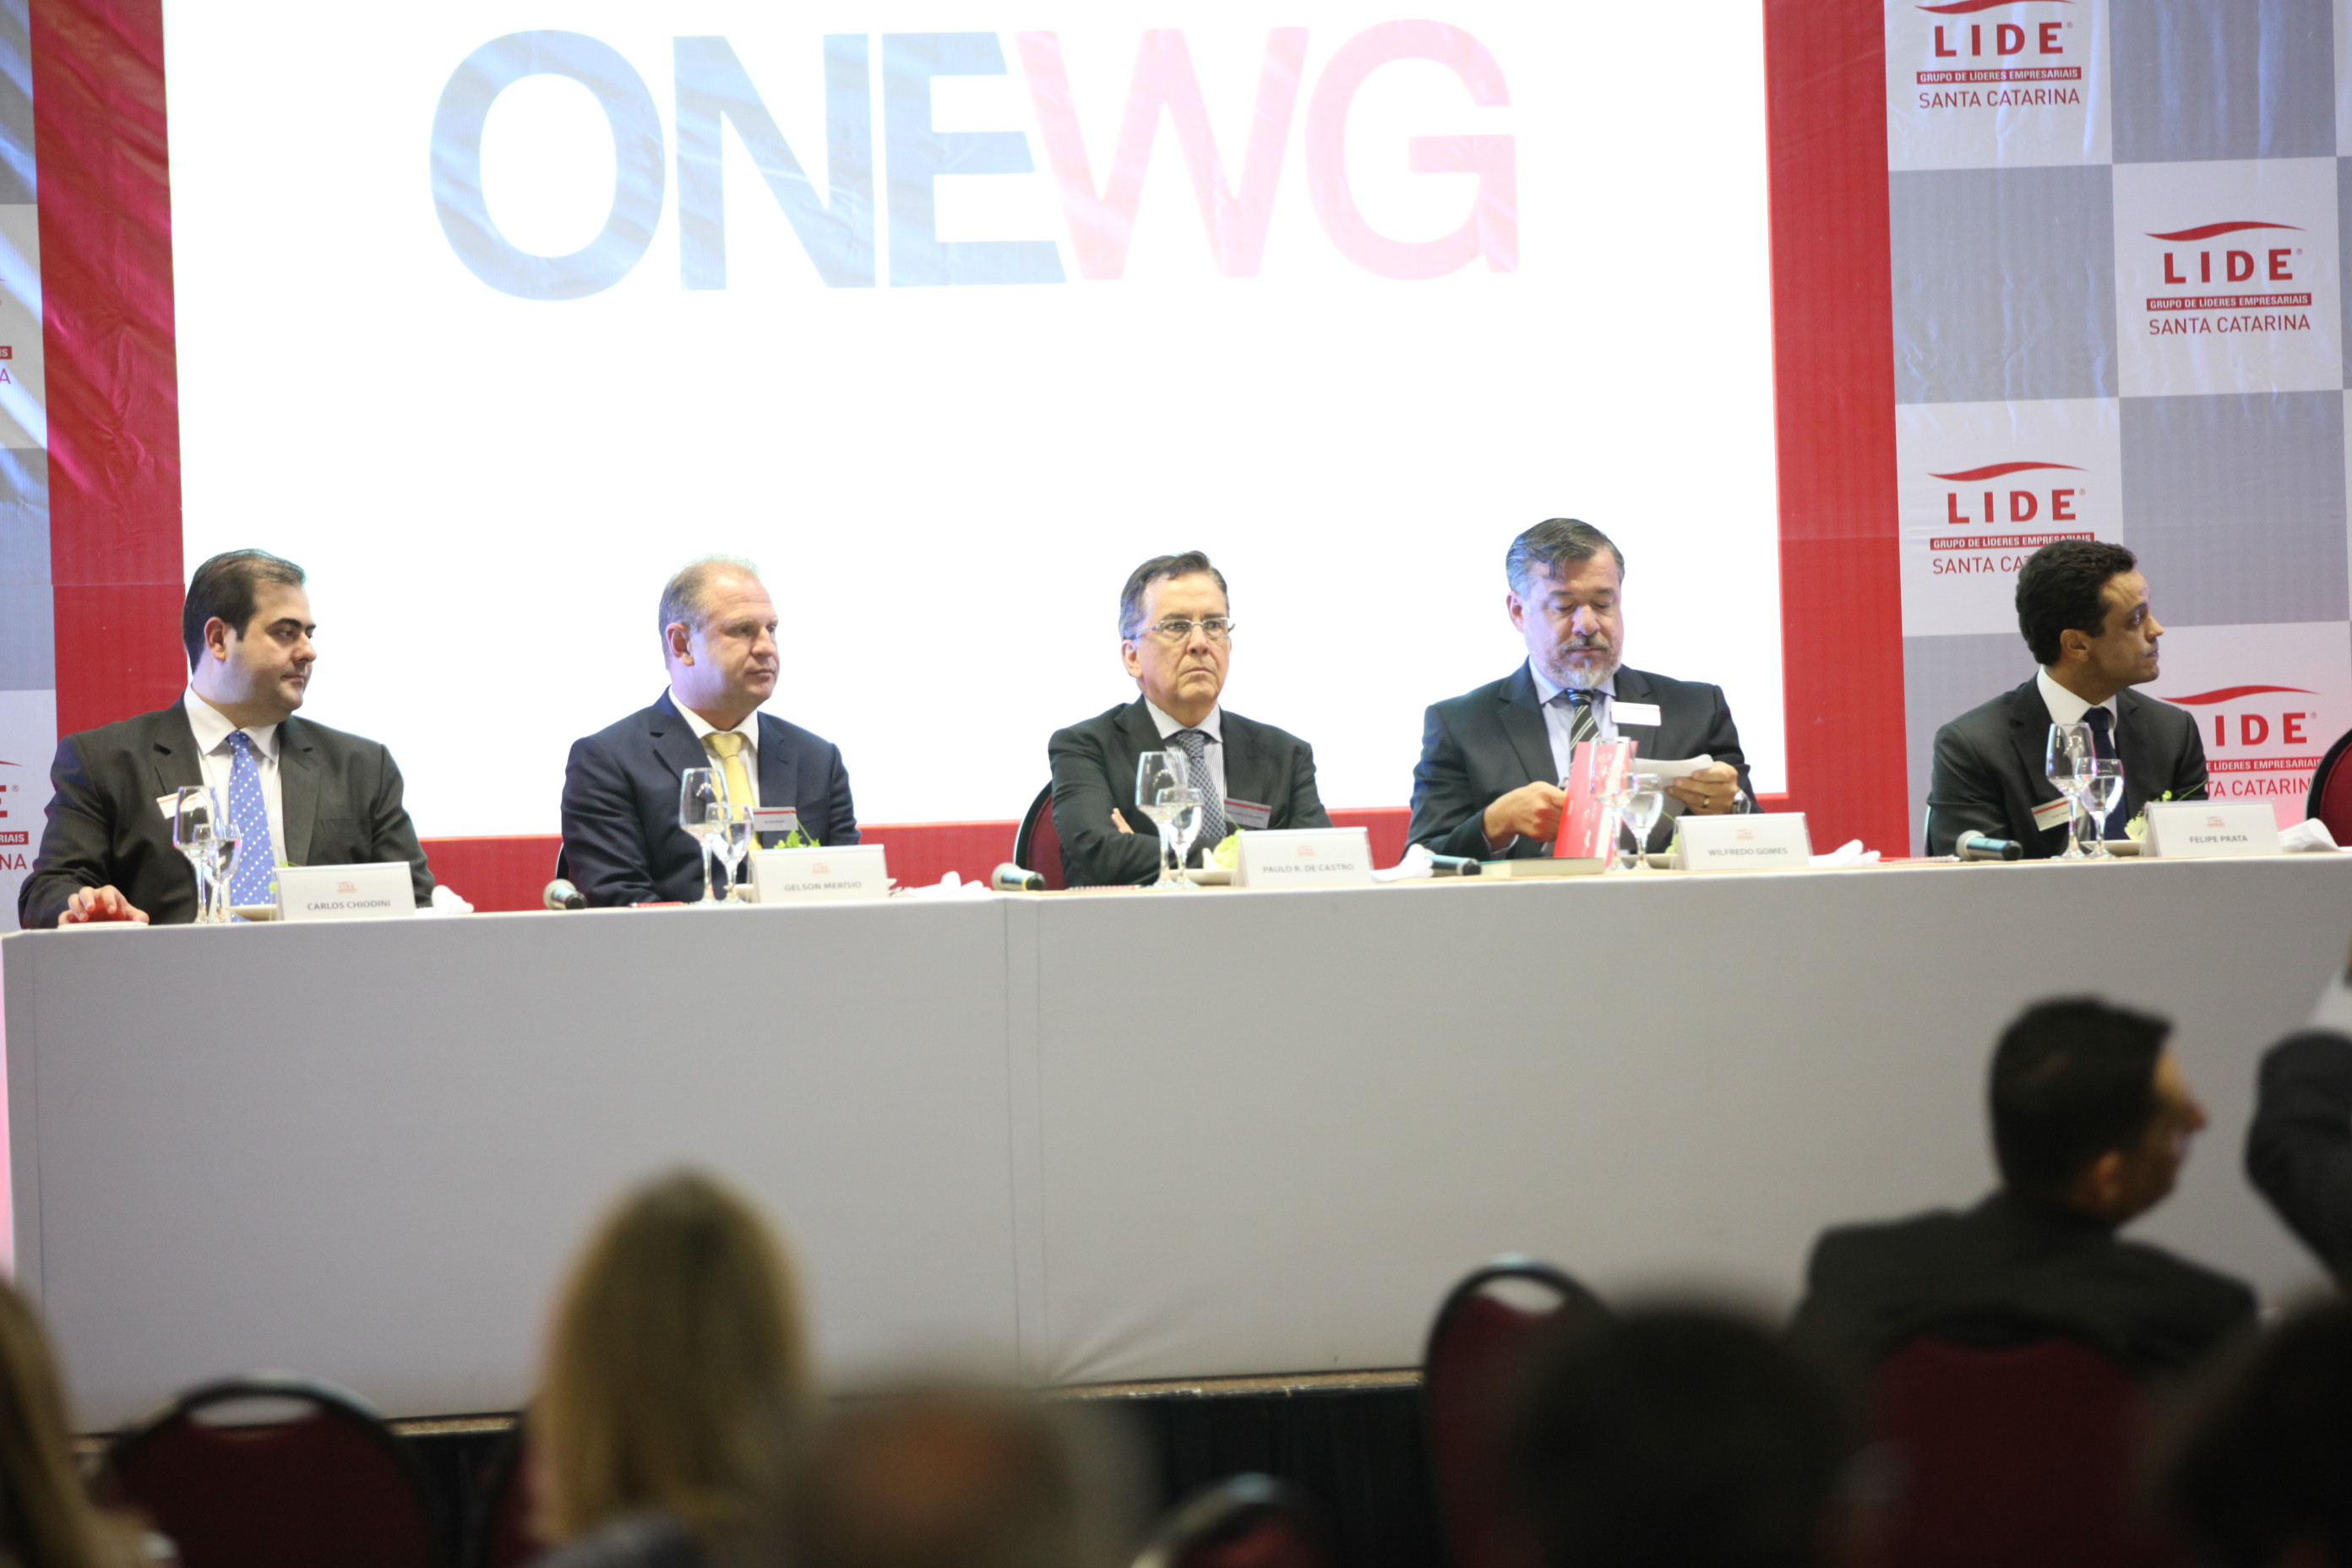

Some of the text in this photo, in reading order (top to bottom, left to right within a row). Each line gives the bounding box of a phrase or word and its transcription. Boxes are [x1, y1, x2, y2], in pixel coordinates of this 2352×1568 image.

[1935, 22, 2063, 57] LIDE
[1920, 68, 2078, 83] GRUPO DE LÍDERES EMPRESARIAIS
[1919, 88, 2081, 109] SANTA CATARINA
[2164, 248, 2293, 285] LIDE
[2150, 295, 2308, 309] GRUPO DE LÍDERES EMPRESARIAIS
[2149, 314, 2311, 335] SANTA CATARINA
[1947, 488, 2076, 525] LIDE
[1933, 538, 1966, 549] GRUPO
[1968, 537, 1980, 547] DE
[1983, 536, 2019, 547] LÍDERES
[1933, 557, 1995, 574] SANTA
[2215, 712, 2307, 747] IDE
[2214, 760, 2251, 771] LÍDERES
[2232, 777, 2311, 797] CATARIN
[1708, 848, 1754, 857] WILFREDO
[1319, 863, 1354, 872] CASTRO
[784, 883, 821, 891] GELSON
[307, 900, 390, 911] CARLOS CHIODINI
